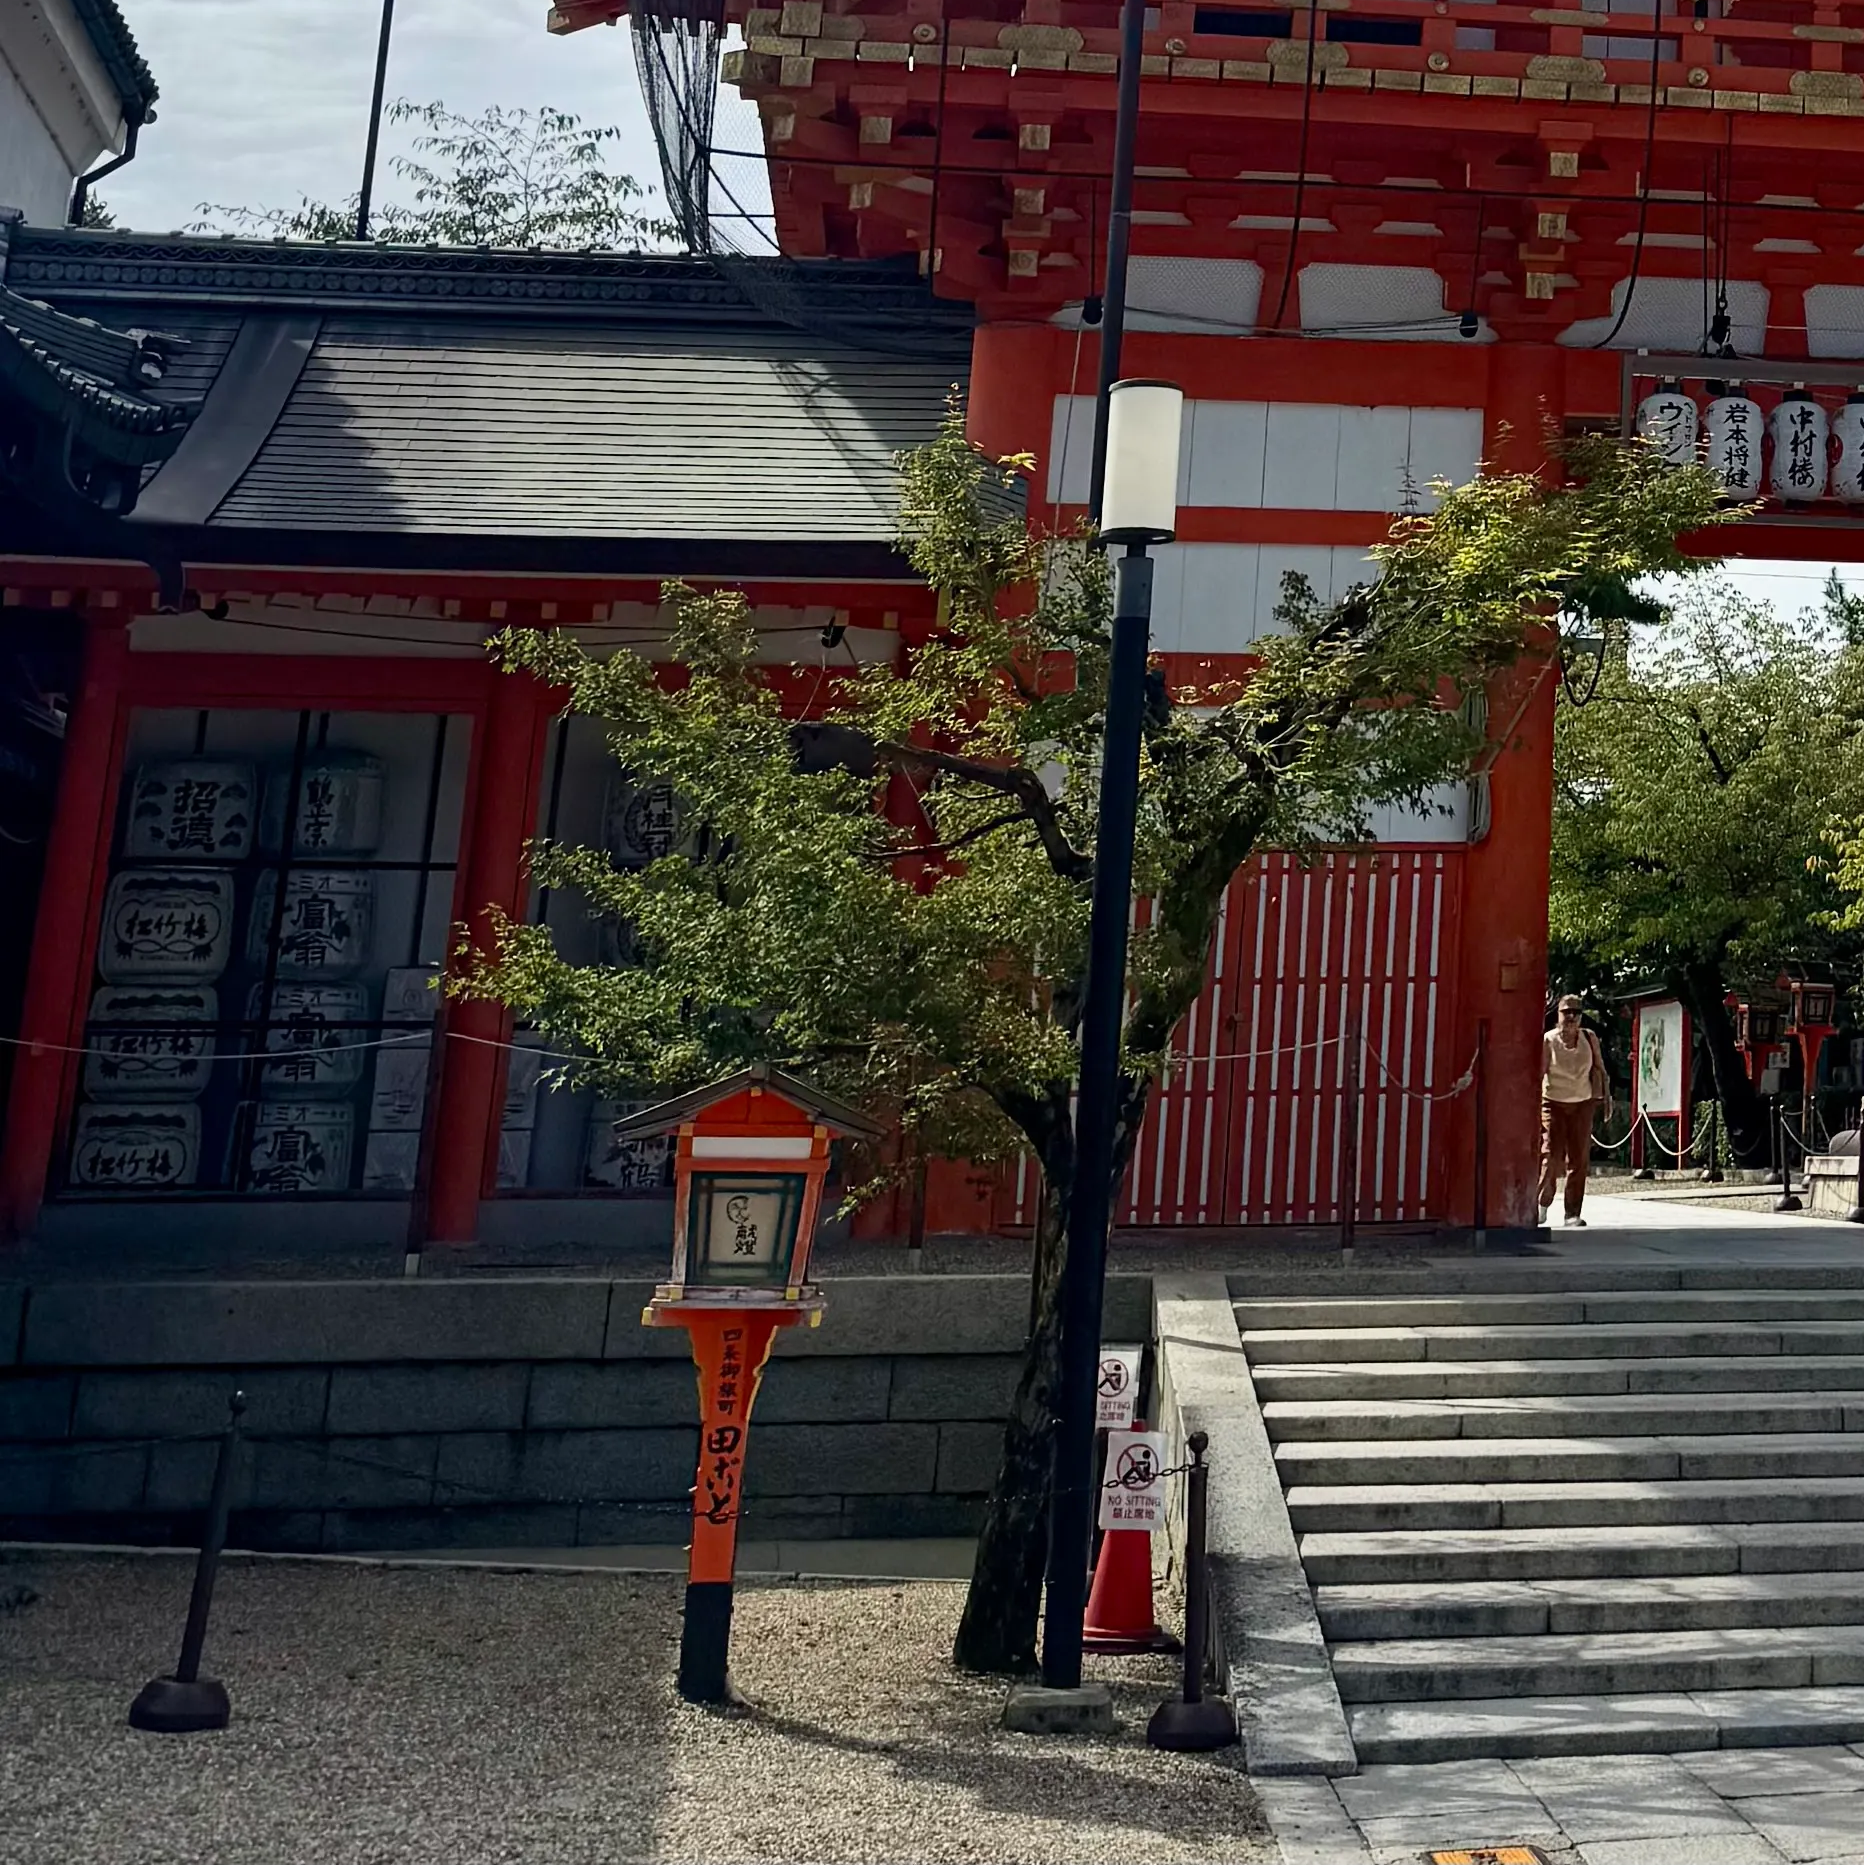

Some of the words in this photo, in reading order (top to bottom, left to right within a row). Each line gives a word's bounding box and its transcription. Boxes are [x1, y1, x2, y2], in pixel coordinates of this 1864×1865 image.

[1723, 402, 1750, 489] 岩本将健
[1108, 1495, 1121, 1506] NO
[1125, 1495, 1161, 1507] SITTING
